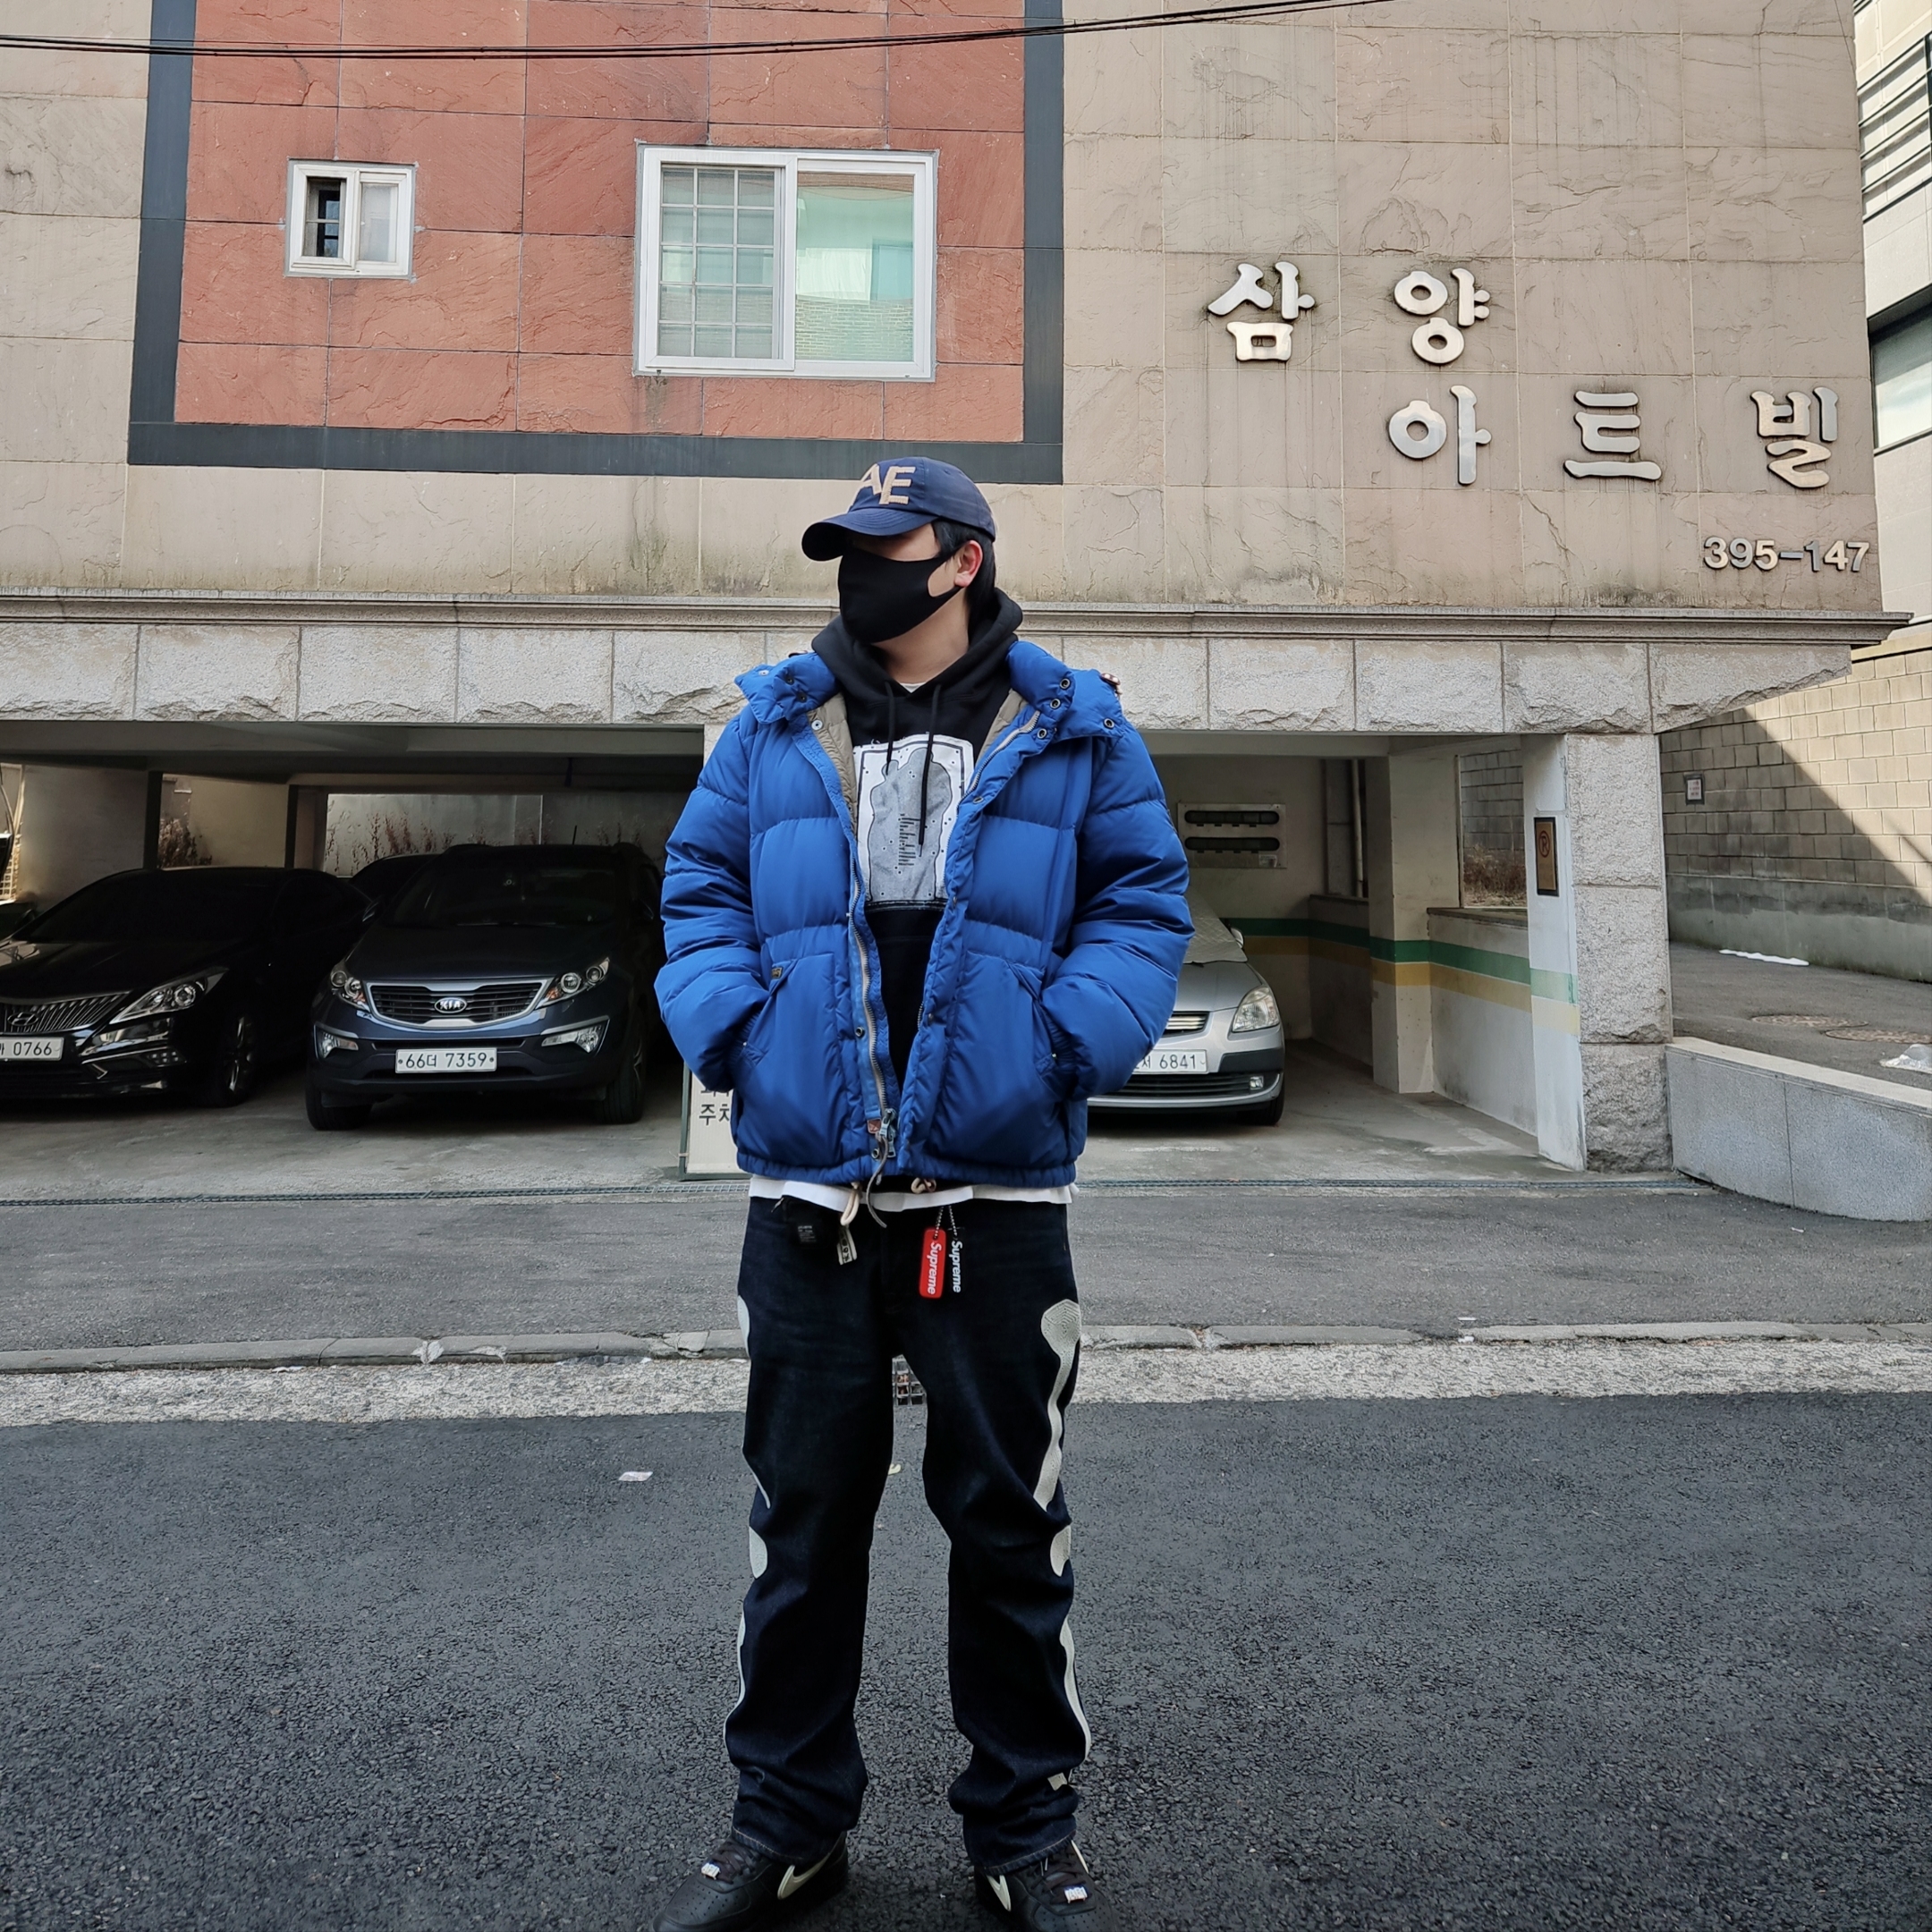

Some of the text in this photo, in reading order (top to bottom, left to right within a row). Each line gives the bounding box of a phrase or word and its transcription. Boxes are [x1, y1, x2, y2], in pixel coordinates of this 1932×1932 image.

[1703, 536, 1871, 572] 395-147
[440, 1000, 462, 1011] KIA
[13, 1041, 53, 1056] 0766
[405, 1052, 487, 1069] 66더 7359
[1159, 1054, 1197, 1070] 6841
[927, 1241, 943, 1295] Supreme
[948, 1240, 963, 1293] Supreme
